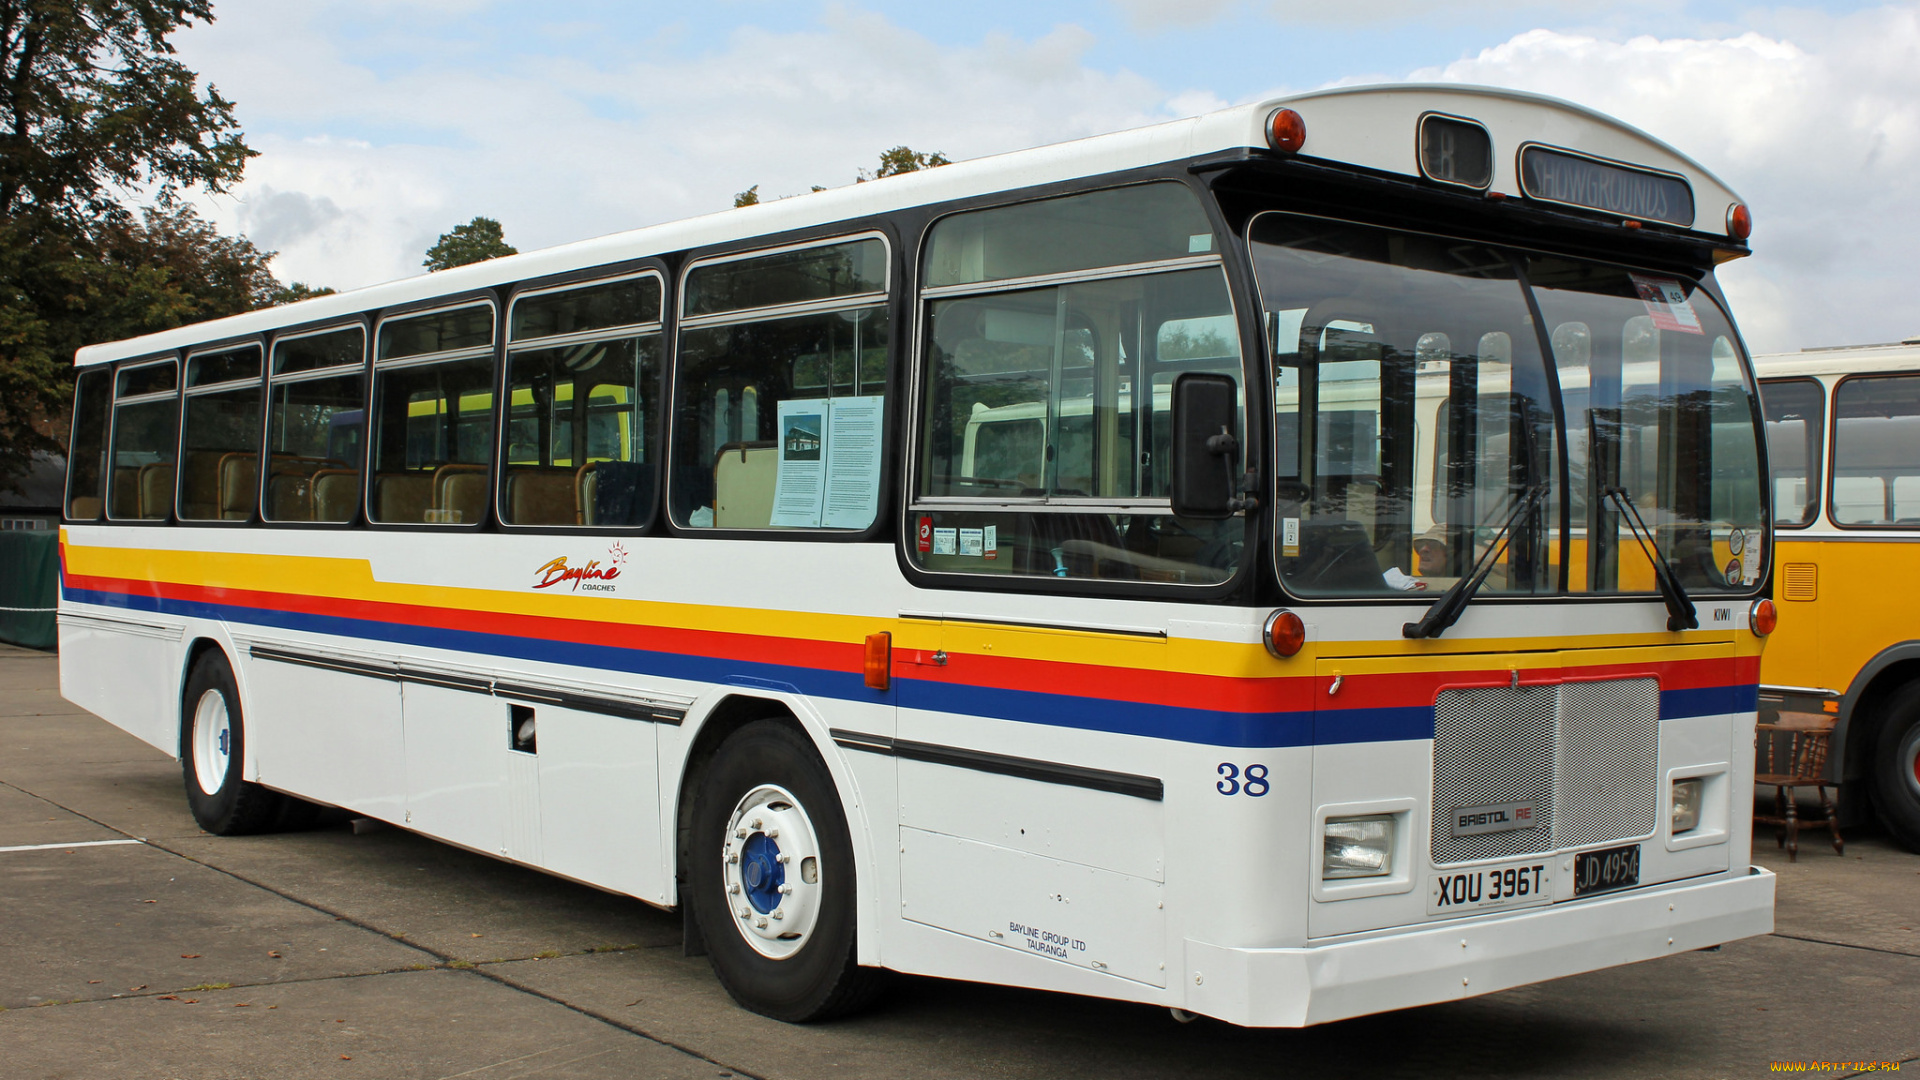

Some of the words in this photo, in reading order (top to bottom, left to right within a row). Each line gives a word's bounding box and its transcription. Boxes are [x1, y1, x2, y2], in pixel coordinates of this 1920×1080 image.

[1532, 156, 1668, 218] SHOWGROUNDS
[1670, 291, 1683, 303] 49
[532, 556, 621, 592] Bayline
[582, 584, 616, 592] COACHES
[1714, 608, 1730, 621] KIWI
[1216, 762, 1270, 797] 38
[1458, 811, 1509, 828] BRISTOL
[1515, 807, 1532, 820] RE
[1578, 857, 1600, 889] JD
[1602, 852, 1638, 885] 4954
[1437, 873, 1483, 907] XOU
[1488, 865, 1545, 900] 396T
[1009, 922, 1039, 938] BAYLINE
[1042, 931, 1069, 946] GROUP
[1071, 939, 1086, 951] LTD
[1026, 938, 1067, 958] TAURANGA
